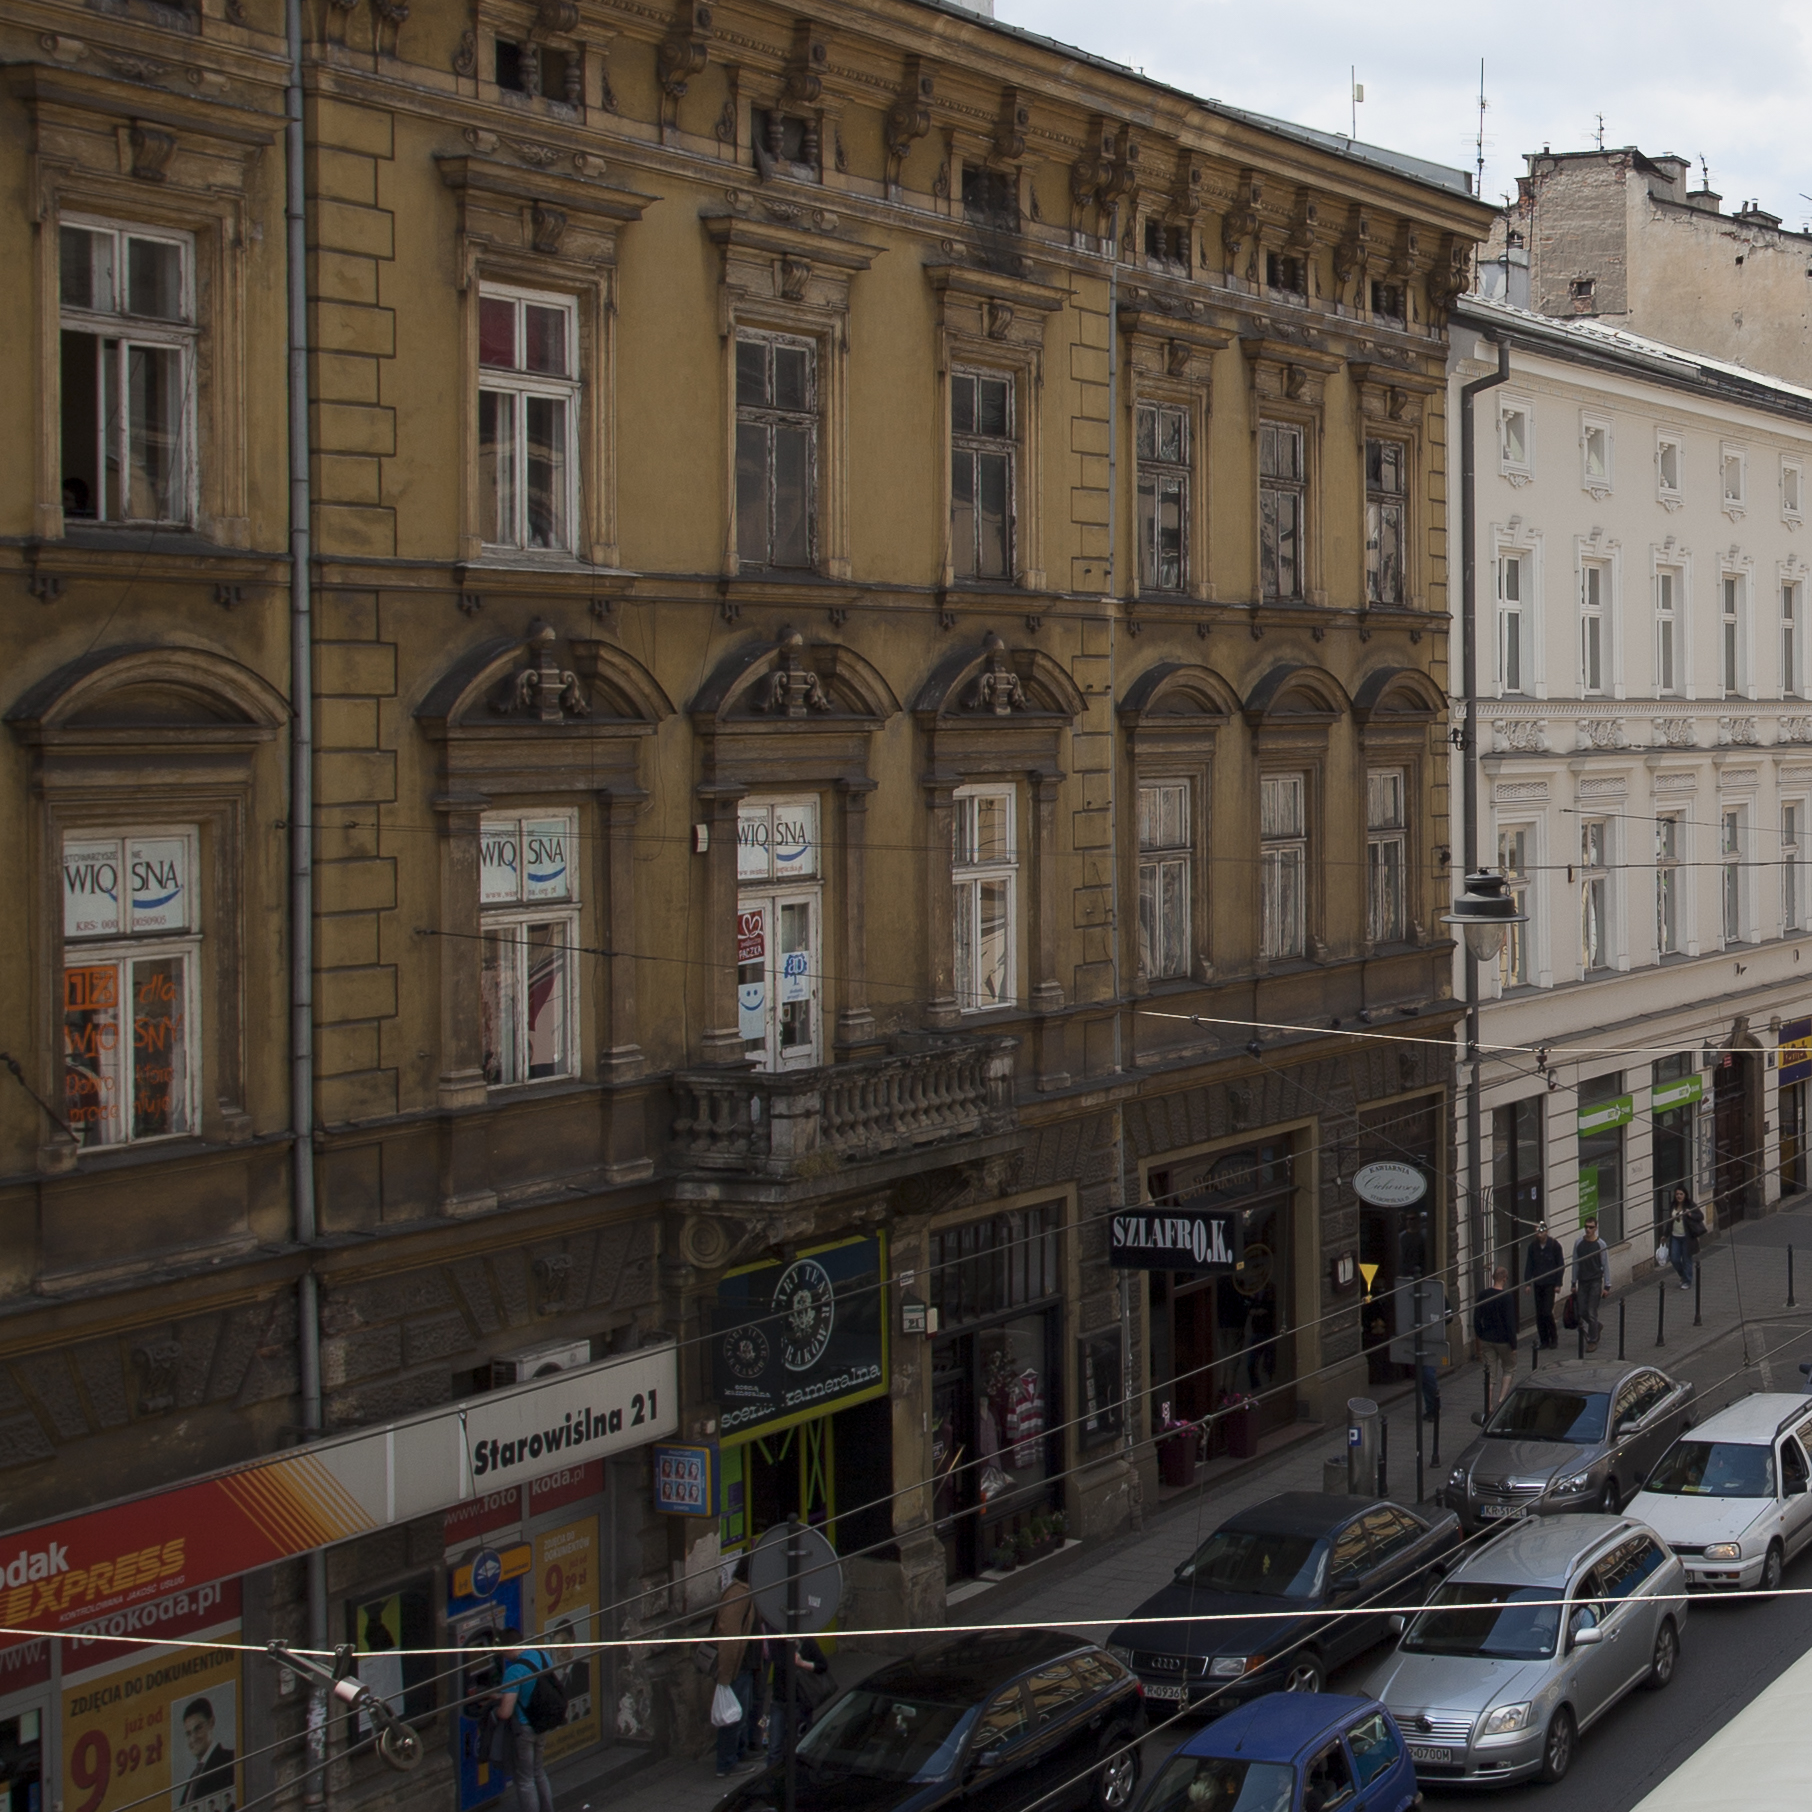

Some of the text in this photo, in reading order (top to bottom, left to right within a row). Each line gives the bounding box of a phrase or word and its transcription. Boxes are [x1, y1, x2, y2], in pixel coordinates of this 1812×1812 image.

[480, 838, 564, 867] WIOSNA
[64, 860, 179, 894] WIOSNA
[139, 974, 176, 1003] dla
[474, 1389, 657, 1476] Starowiślna 21
[1349, 1429, 1358, 1444] P
[0, 1541, 69, 1590] dak
[4, 1537, 186, 1627] EXPRESS
[545, 1563, 563, 1615] 9
[70, 1684, 122, 1718] ZDJĘCIA
[124, 1678, 143, 1698] DO
[124, 1706, 163, 1739] już od
[116, 1743, 141, 1777] 99
[145, 1734, 163, 1766] zł
